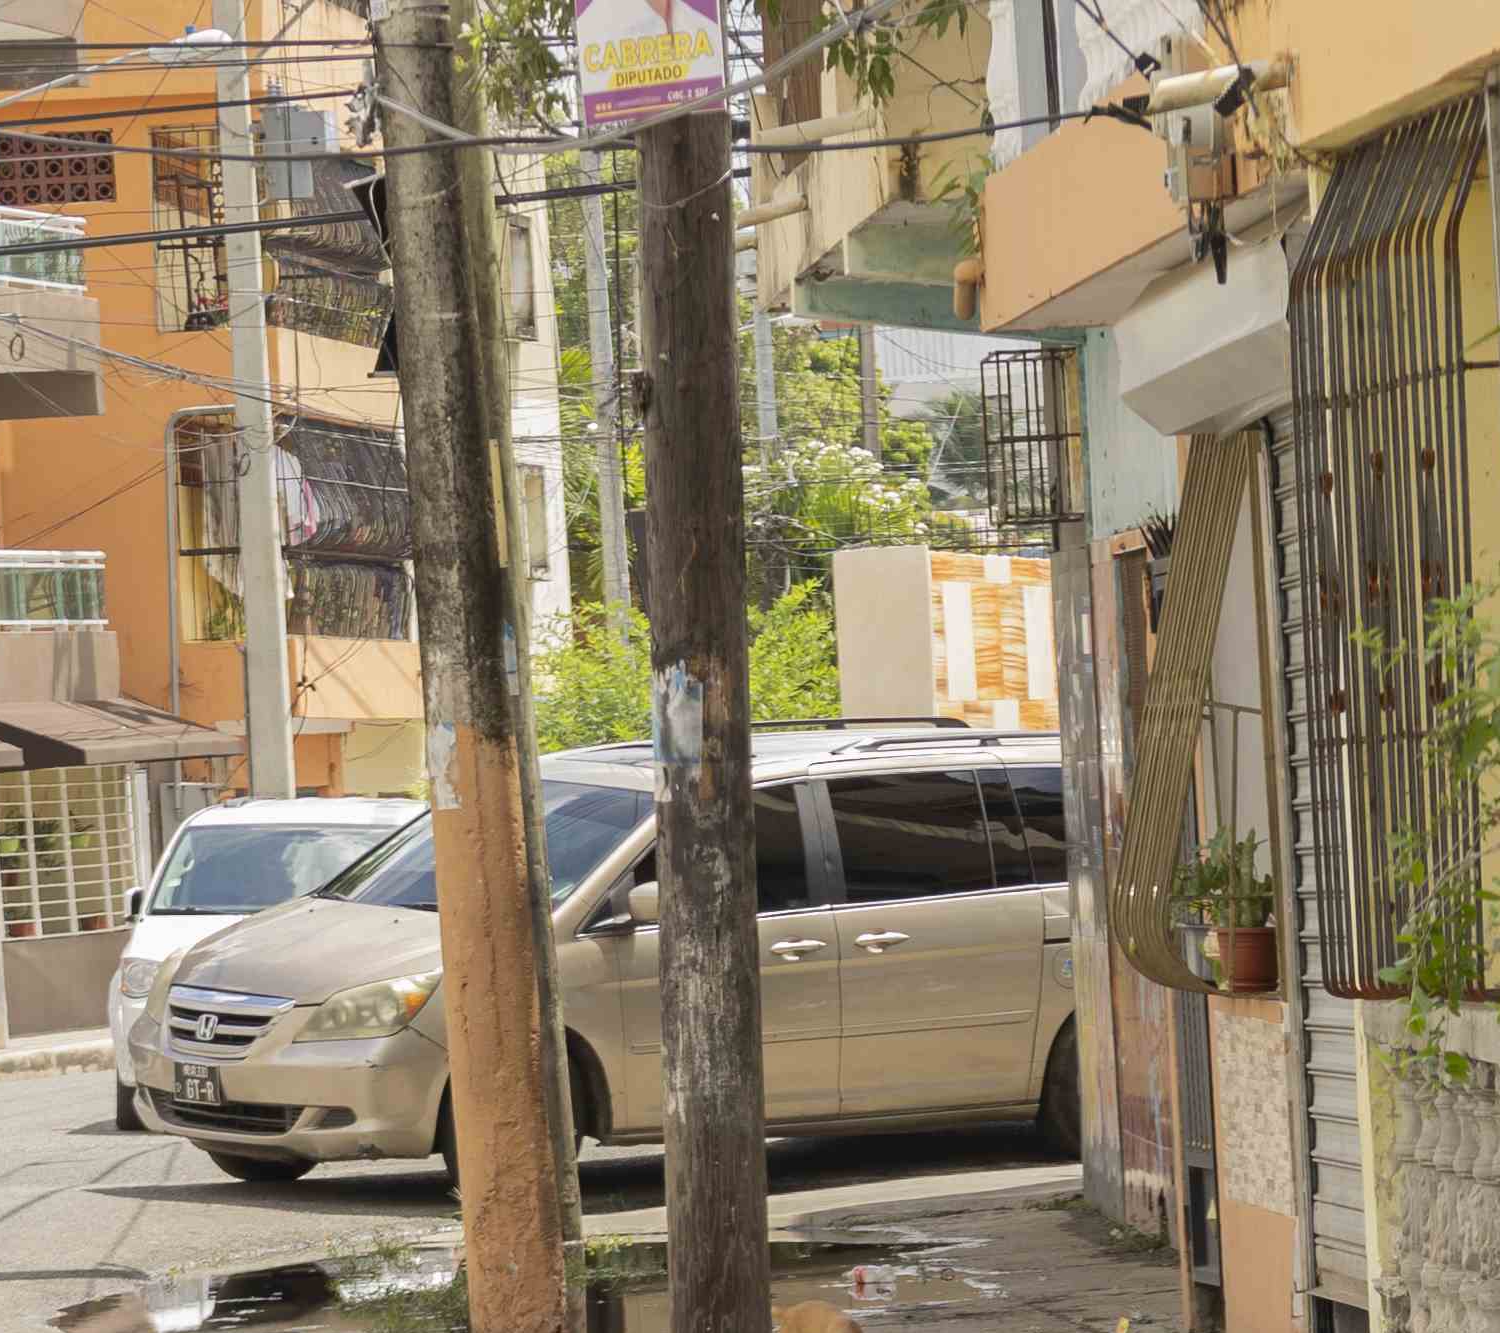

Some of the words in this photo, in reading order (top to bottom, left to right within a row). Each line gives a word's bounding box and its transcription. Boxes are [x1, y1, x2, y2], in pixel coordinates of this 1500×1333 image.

[584, 30, 713, 72] CABRERA
[615, 64, 683, 87] DIPUTADO
[185, 1078, 215, 1102] GT-R
